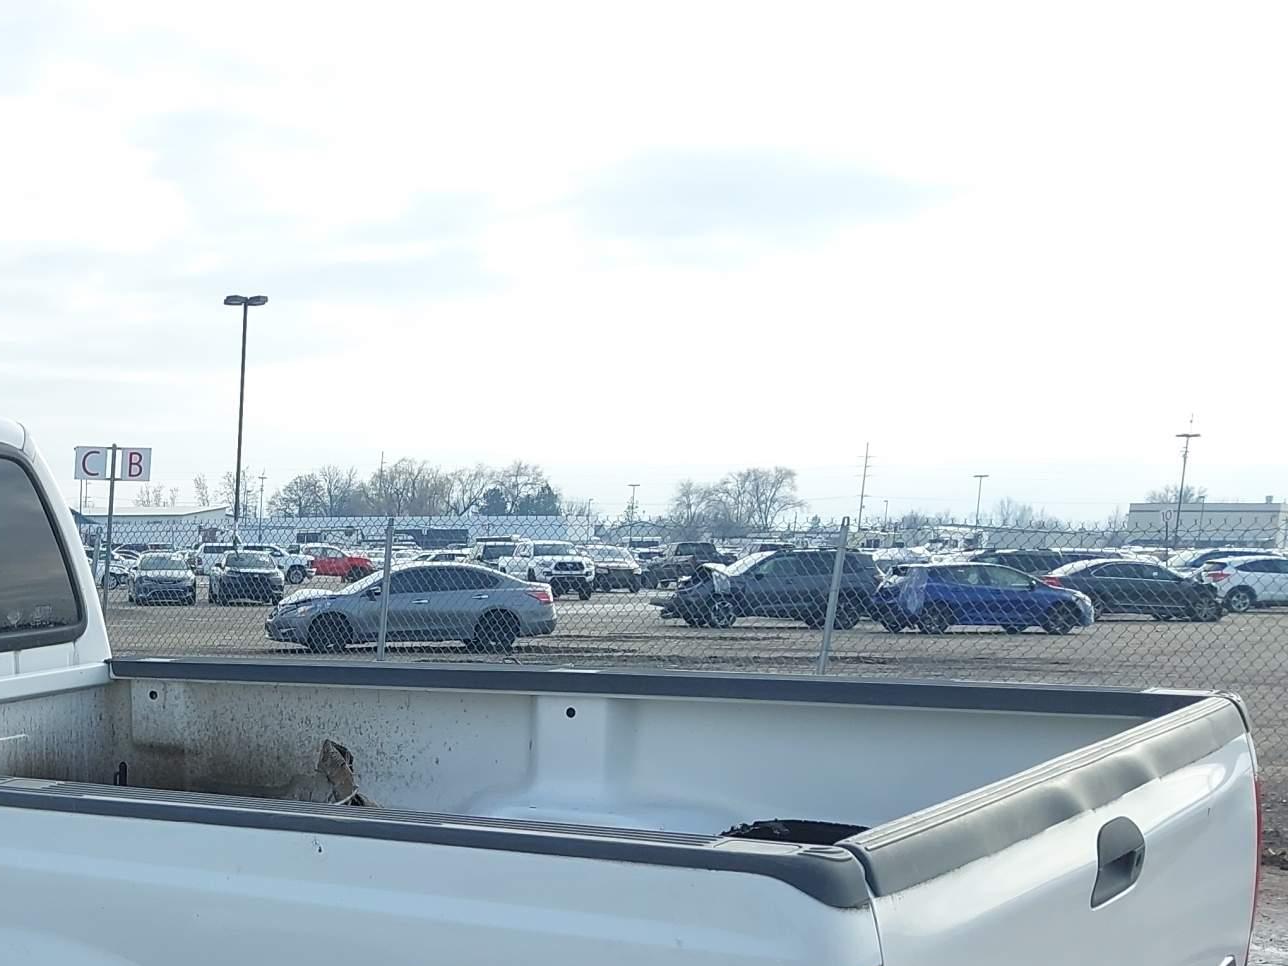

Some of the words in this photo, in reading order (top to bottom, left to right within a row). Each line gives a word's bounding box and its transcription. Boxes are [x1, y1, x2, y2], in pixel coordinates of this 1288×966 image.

[82, 450, 101, 477] C
[128, 451, 143, 478] B
[1162, 510, 1173, 522] 10
